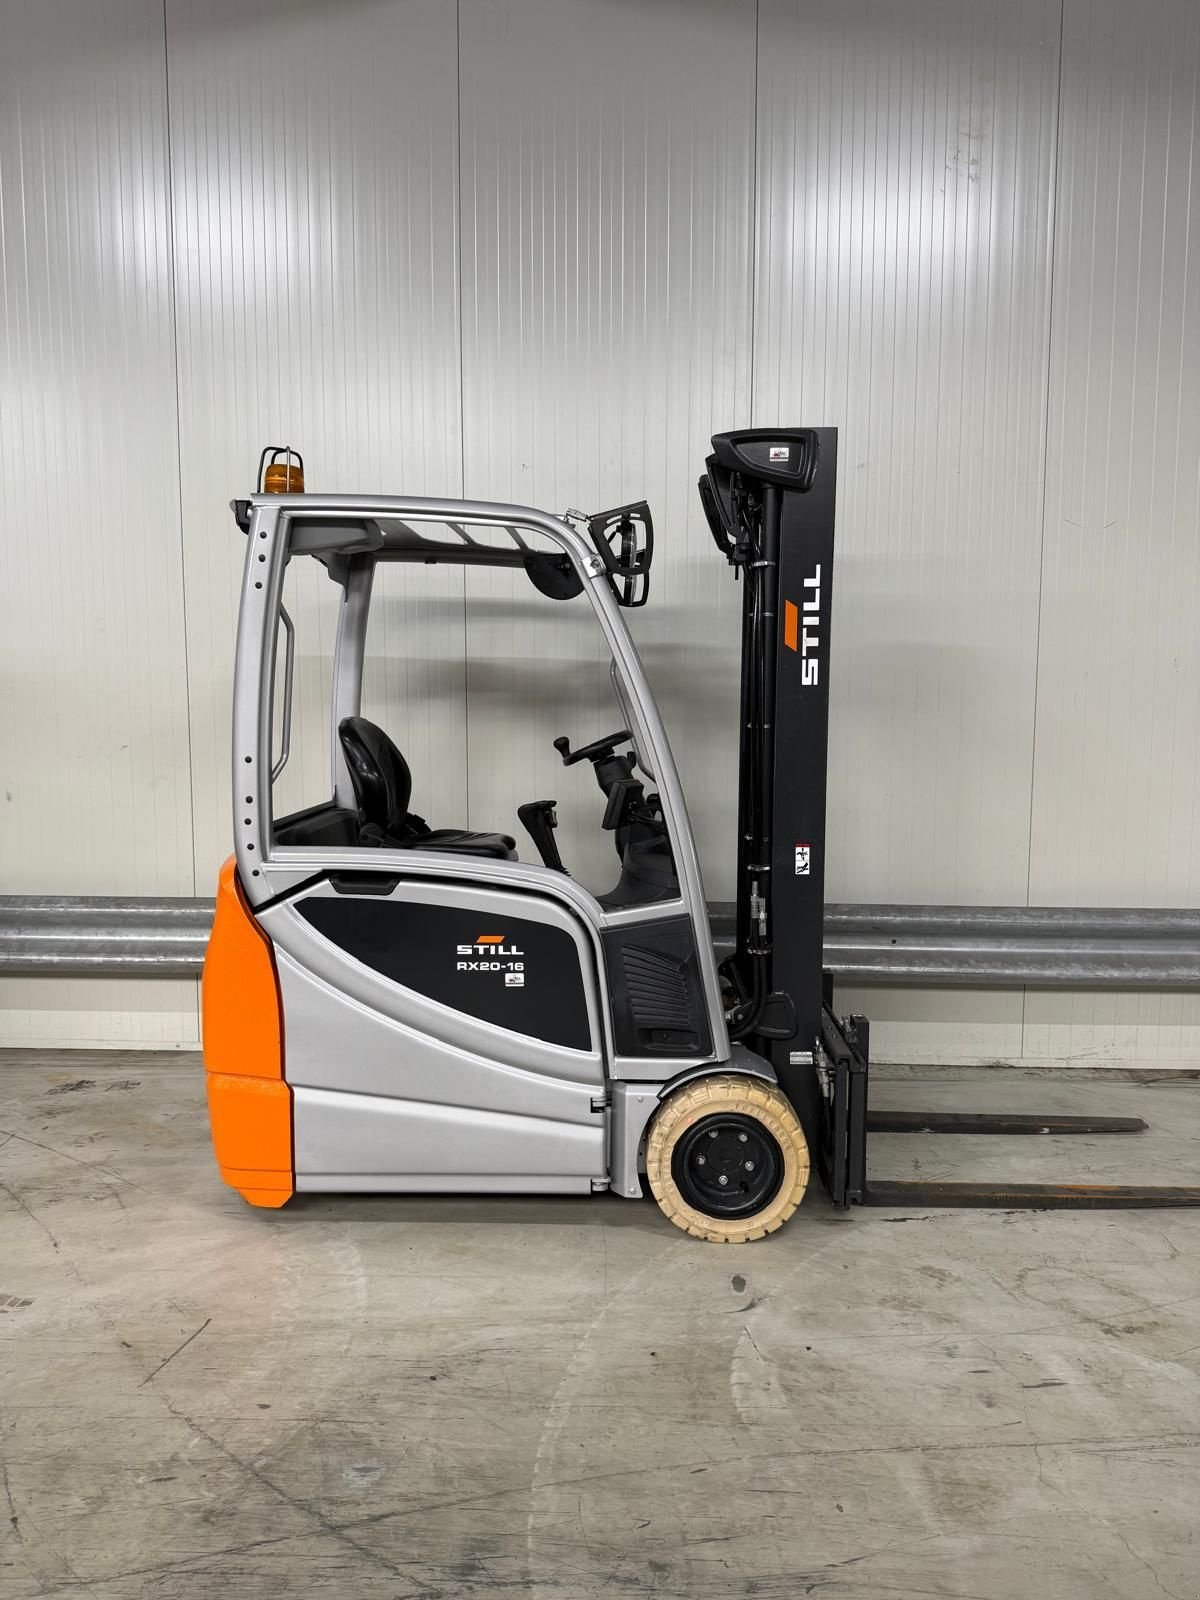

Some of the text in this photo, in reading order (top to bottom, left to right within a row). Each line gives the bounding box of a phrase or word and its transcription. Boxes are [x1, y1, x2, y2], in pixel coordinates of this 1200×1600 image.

[801, 564, 821, 686] STILL
[456, 945, 525, 955] STILL
[456, 961, 525, 971] RX20-16
